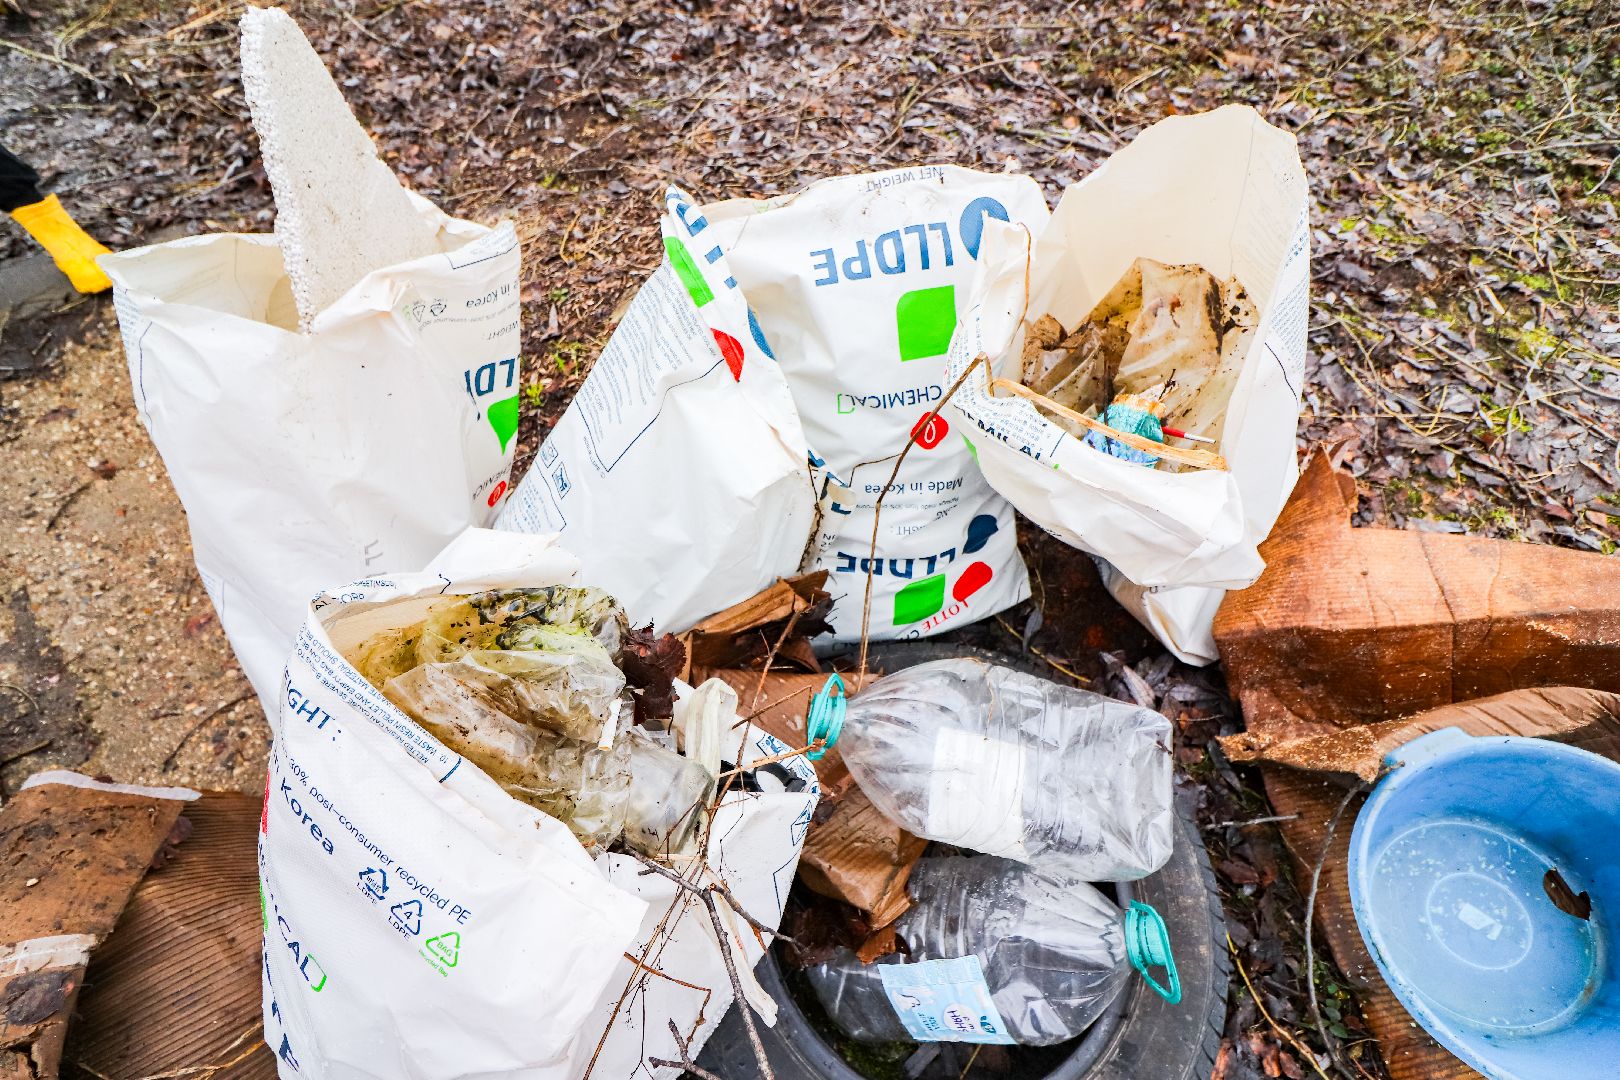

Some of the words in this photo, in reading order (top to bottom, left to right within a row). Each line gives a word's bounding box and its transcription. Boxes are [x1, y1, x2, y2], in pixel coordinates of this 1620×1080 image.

[865, 175, 916, 193] WEIGHT
[919, 167, 944, 181] NET
[809, 221, 954, 287] LLDPE
[466, 289, 498, 309] Korea
[844, 385, 943, 410] CHEMICAL
[910, 481, 923, 494] in
[928, 476, 963, 491] Made
[921, 599, 969, 634] LOTTE
[311, 638, 338, 665] SHOULD
[319, 660, 334, 676] BAG
[336, 661, 369, 690] MATERIAL
[320, 677, 348, 700] SEVERE
[331, 674, 355, 695] EMPTY
[353, 691, 371, 706] AND
[368, 702, 395, 724] PELLET
[392, 720, 415, 739] RESIN
[402, 740, 429, 763] MELTED
[412, 734, 437, 756] WASTE
[281, 777, 334, 856] Korea
[308, 786, 394, 867] post-consumer
[395, 866, 450, 910] recycled
[447, 904, 472, 925] PE
[404, 911, 413, 920] 4
[388, 915, 412, 940] LDPE
[436, 941, 453, 957] BAG
